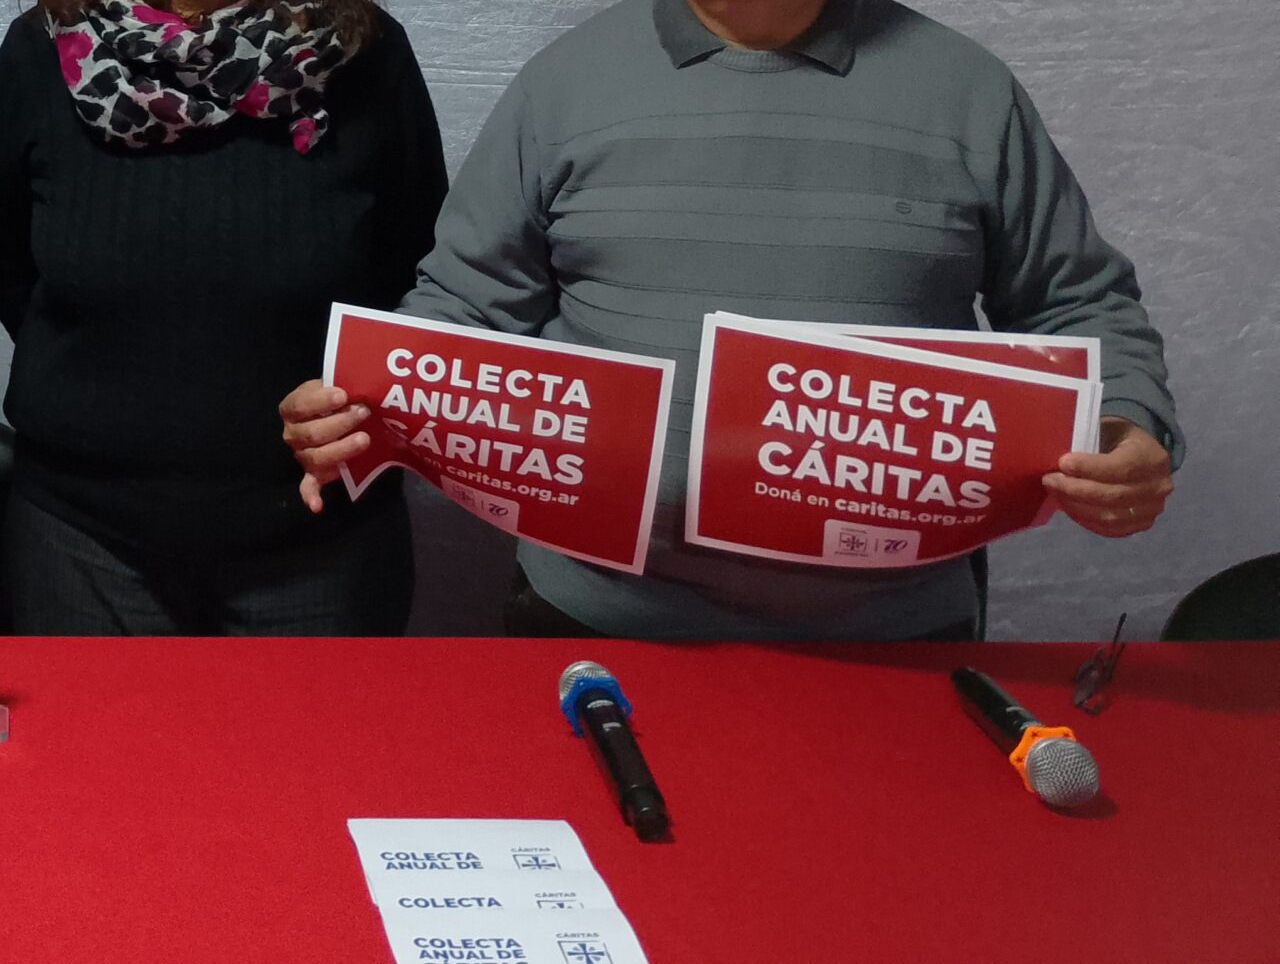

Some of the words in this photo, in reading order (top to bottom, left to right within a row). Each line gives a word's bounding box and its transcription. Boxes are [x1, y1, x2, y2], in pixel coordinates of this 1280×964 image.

[386, 348, 591, 409] COLECTA
[767, 363, 997, 432] COLECTA
[381, 384, 520, 432] ANUAL
[532, 409, 589, 444] DE
[762, 400, 918, 457] ANUAL
[931, 431, 995, 470] DE
[446, 464, 579, 506] caritas.org.ar
[757, 437, 992, 509] CÁRITAS
[754, 482, 802, 504] Doná
[806, 491, 830, 508] en
[835, 497, 986, 527] caritas.org.ar
[380, 851, 480, 861] COLECTA
[385, 861, 453, 870] ANUAL
[459, 861, 484, 870] DE
[398, 897, 502, 908] COLECTA
[413, 938, 522, 949] COLECTA
[419, 949, 493, 960] ANUAL
[497, 948, 526, 959] DE
